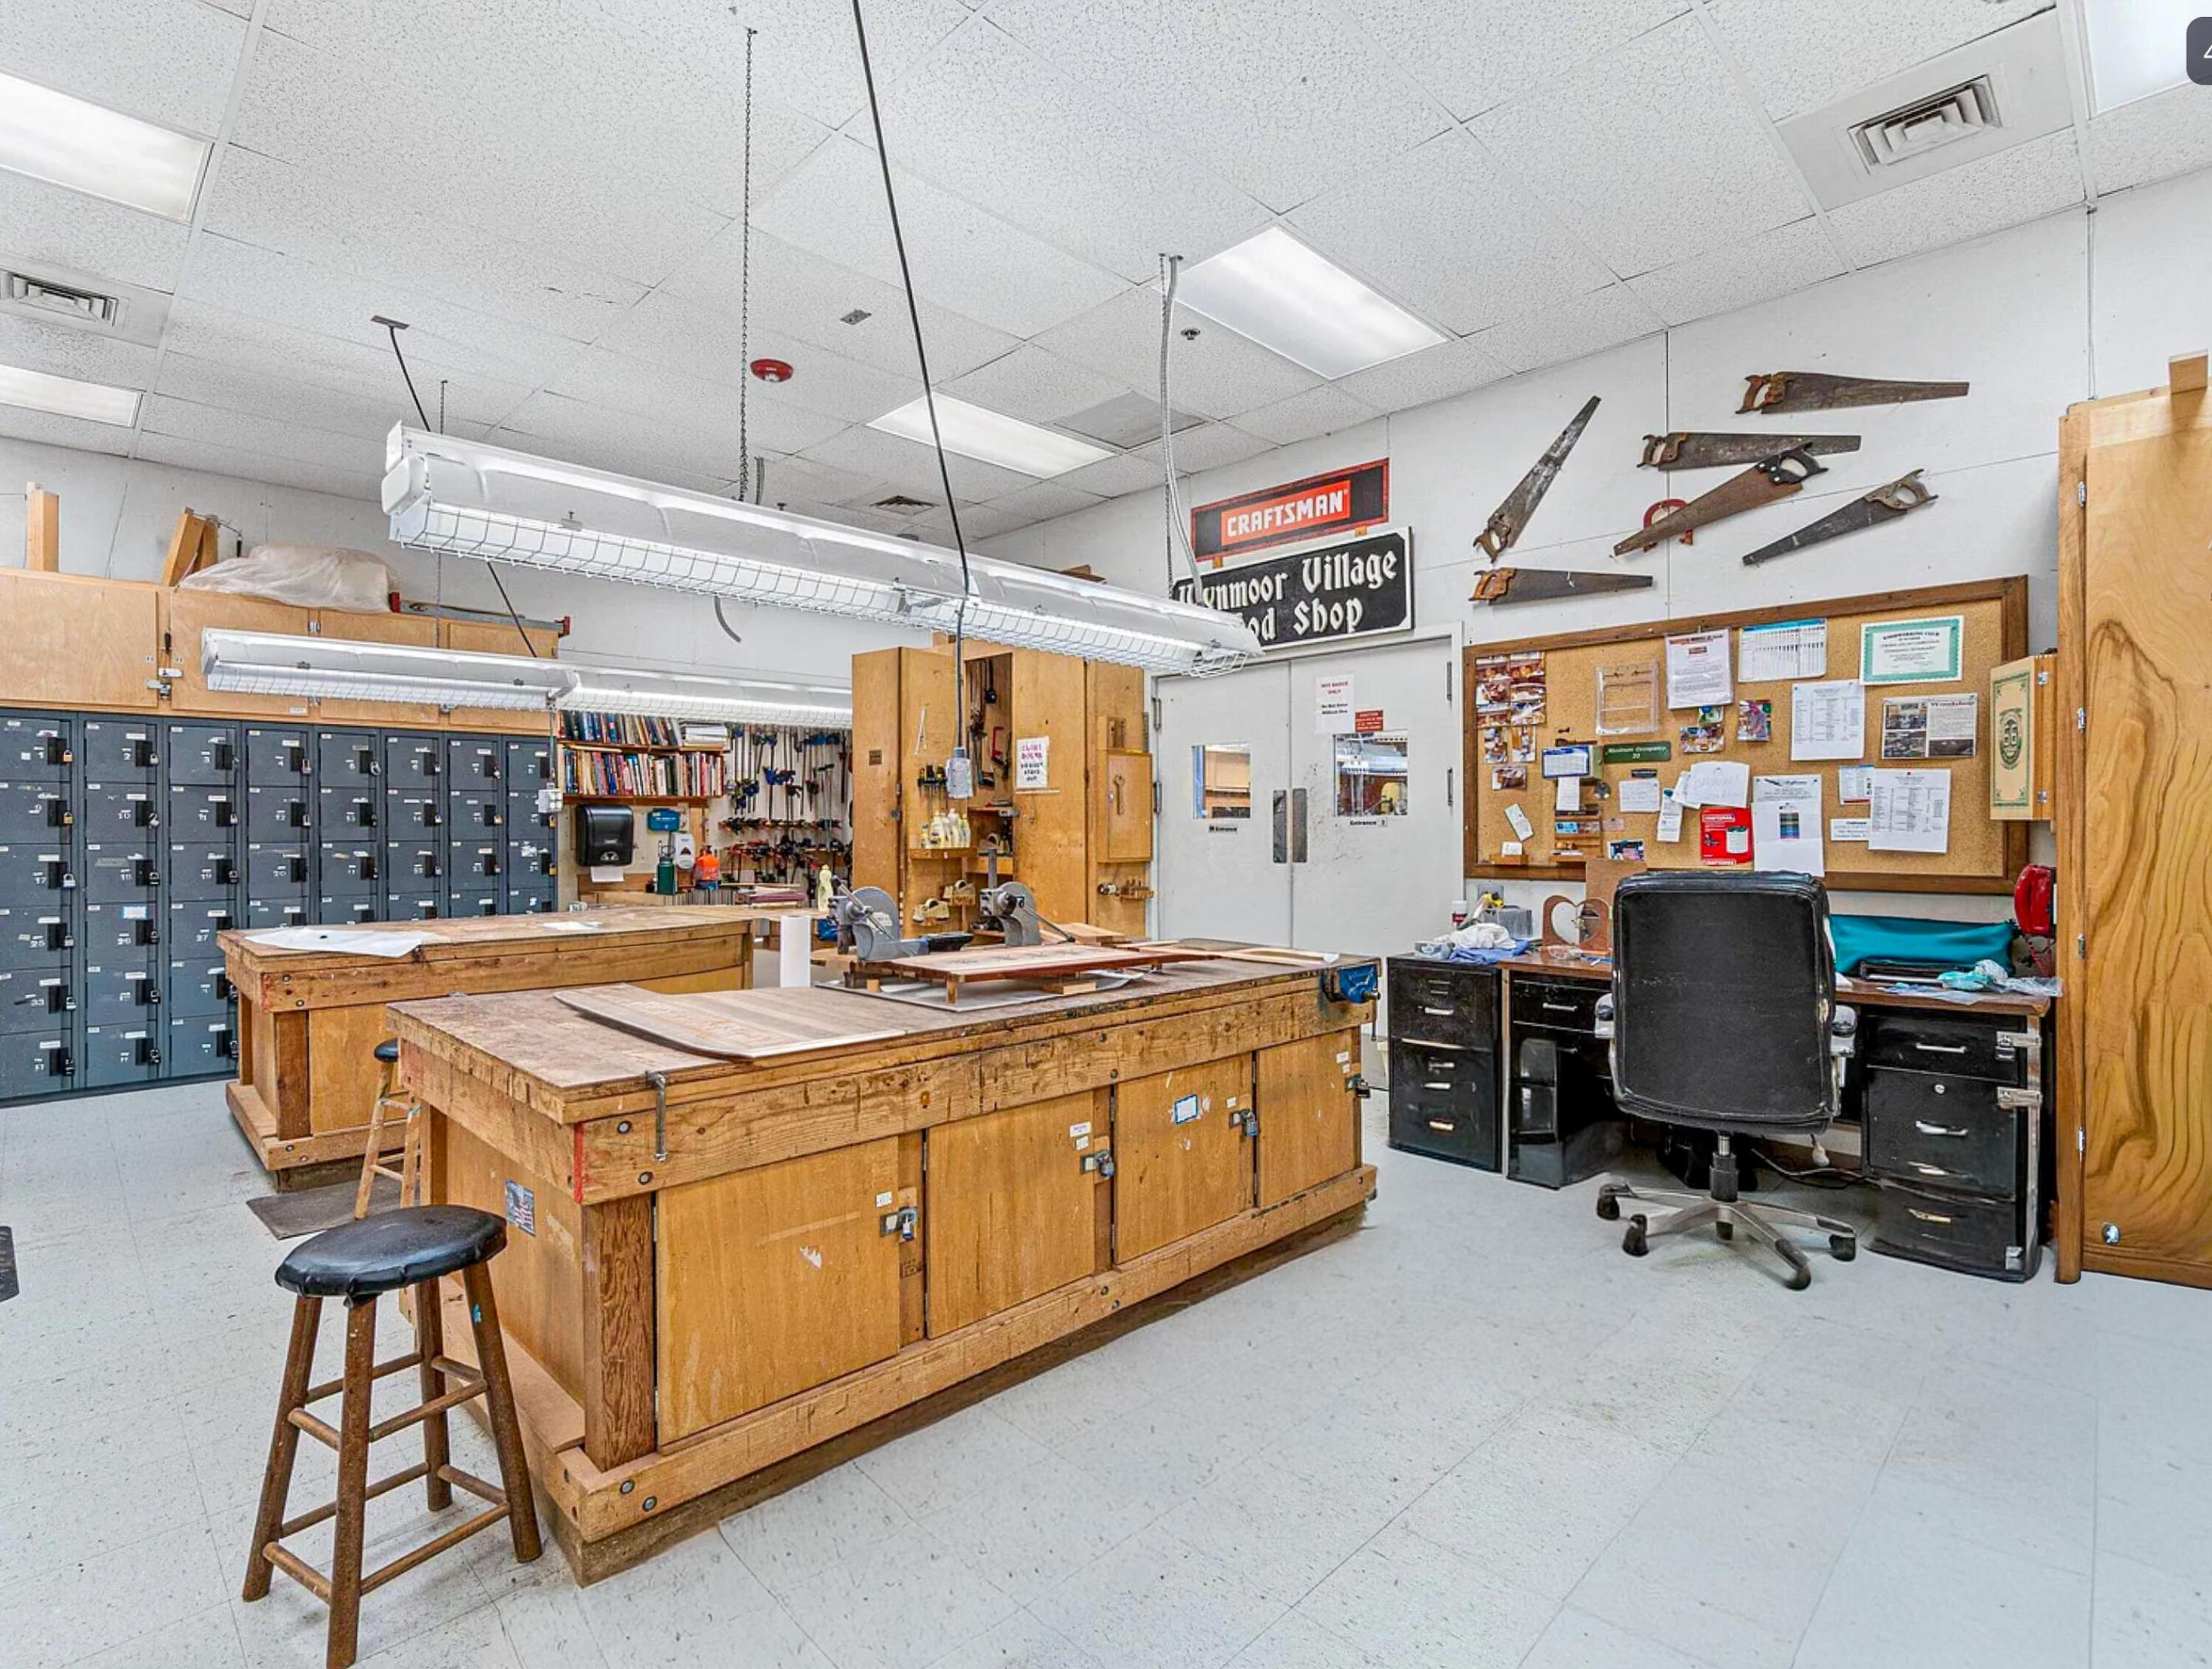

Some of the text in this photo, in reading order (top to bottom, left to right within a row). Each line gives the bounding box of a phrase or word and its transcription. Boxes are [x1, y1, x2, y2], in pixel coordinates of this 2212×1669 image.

[1227, 489, 1344, 536] CRAFTSMAN
[1302, 550, 1397, 593] Village
[1293, 597, 1363, 635] Shop
[34, 876, 47, 885] 17
